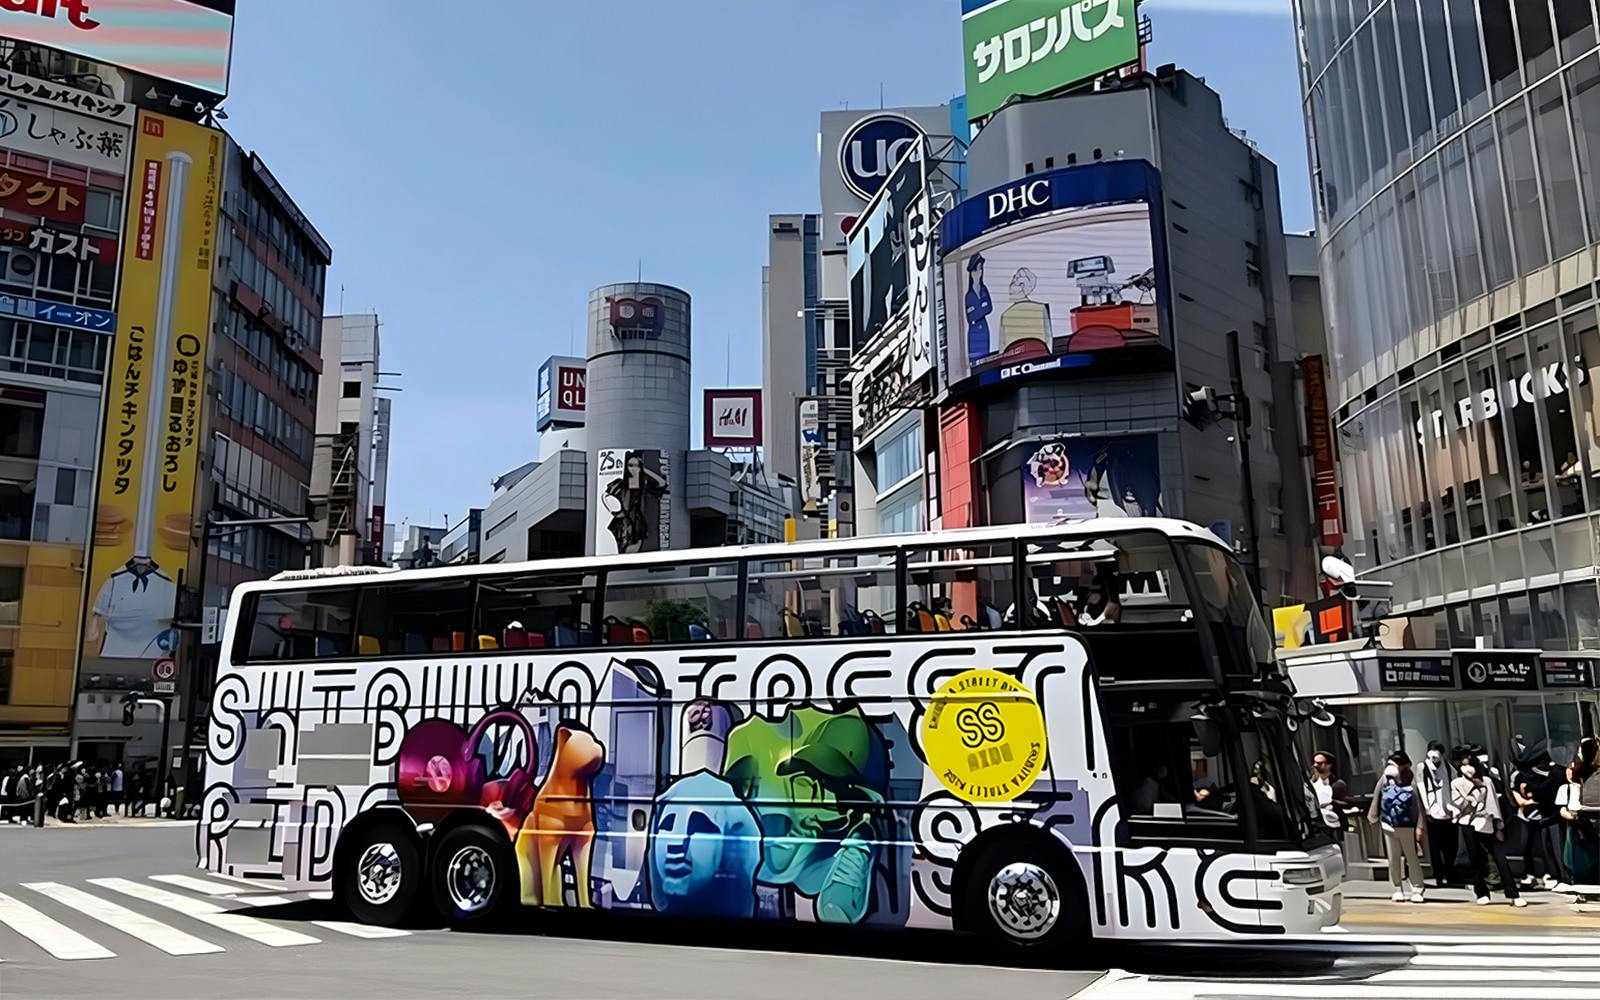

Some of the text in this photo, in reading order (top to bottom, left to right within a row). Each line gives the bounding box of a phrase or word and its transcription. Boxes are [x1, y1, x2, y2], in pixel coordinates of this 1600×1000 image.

[973, 0, 1124, 83] サロンパス
[988, 179, 1051, 220] DHC
[28, 228, 101, 260] ガスト
[1416, 354, 1586, 446] STRBUCKS
[612, 644, 1066, 771] TREET
[956, 701, 1005, 748] SS
